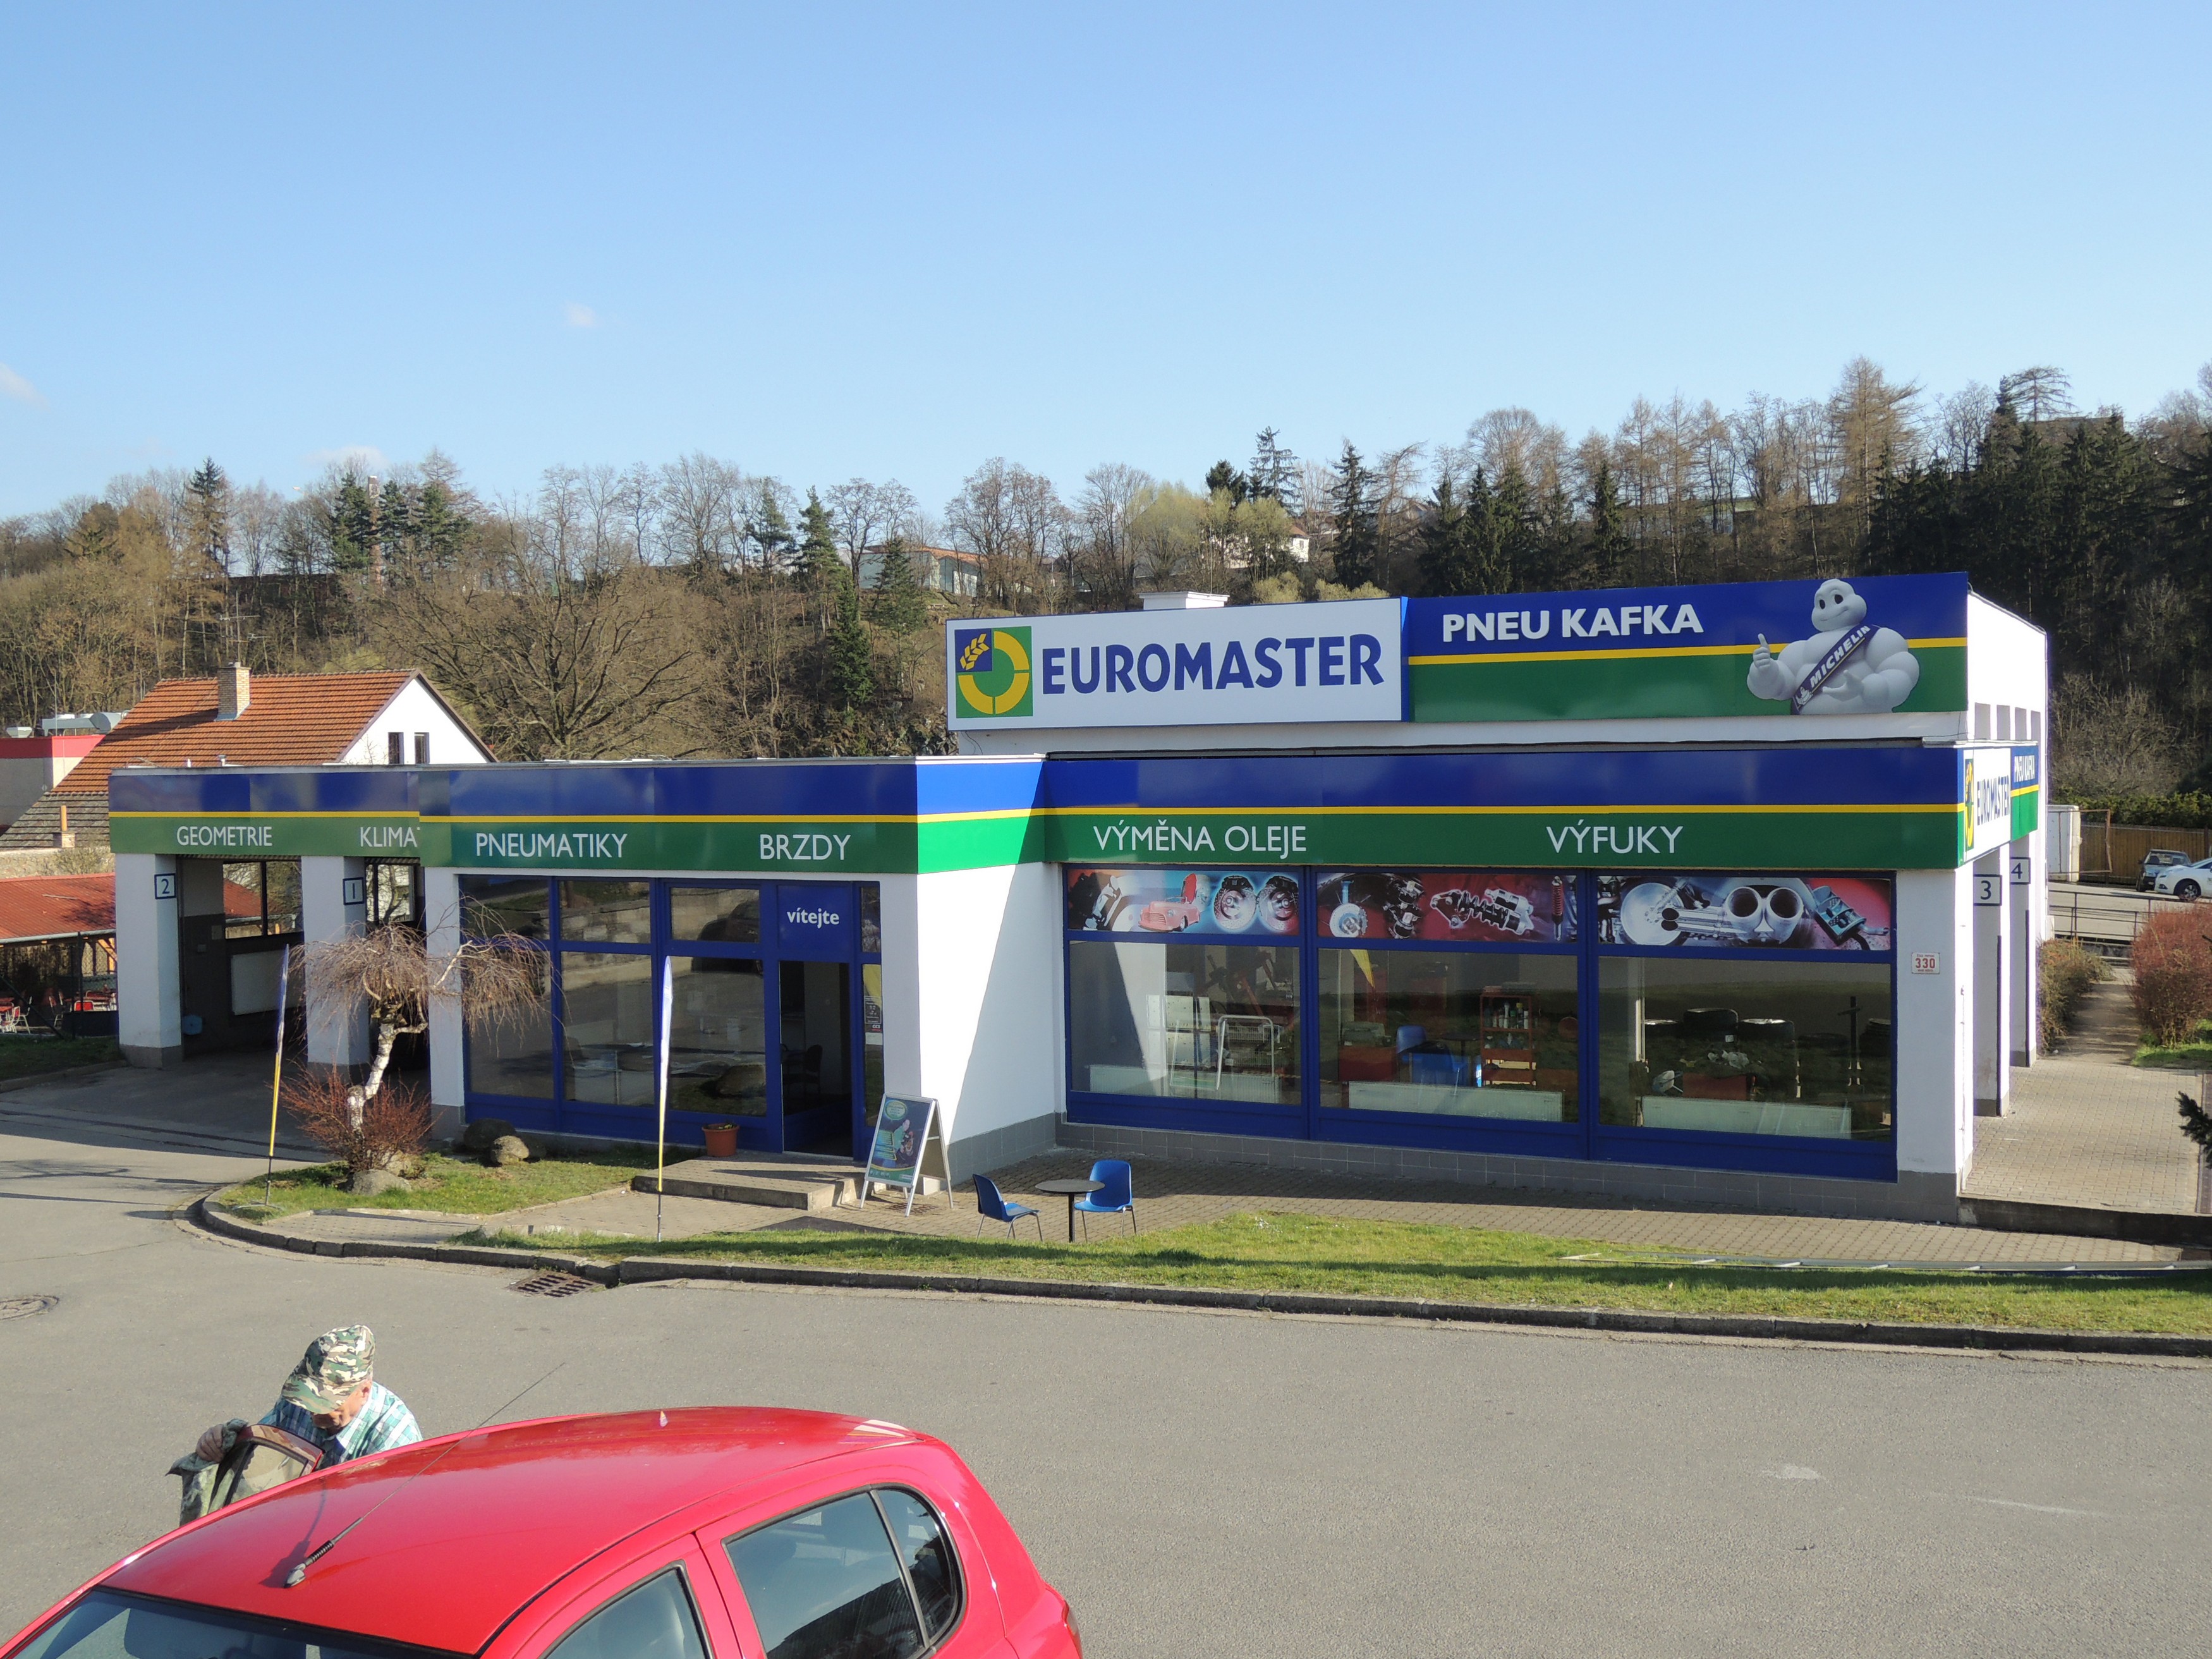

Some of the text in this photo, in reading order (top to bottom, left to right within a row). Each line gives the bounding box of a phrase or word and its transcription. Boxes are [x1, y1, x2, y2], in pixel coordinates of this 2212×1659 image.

[1443, 604, 1704, 643] PNEU KAFKA
[1043, 633, 1385, 695] EUROMASTER
[1809, 625, 1871, 688] MICHELIN
[1977, 775, 2010, 826] EUROMASTER
[176, 825, 272, 847] GEOMETRIE
[360, 826, 420, 848] KLIMA
[476, 832, 628, 858] PNEUMATIKY
[760, 834, 851, 861] BRZDY
[1093, 818, 1307, 860] VÝMĚNA OLEJE
[1546, 819, 1684, 854] VÝFUKY
[2011, 863, 2022, 879] 4
[161, 878, 169, 894] 2
[1980, 880, 1991, 900] 3
[786, 907, 839, 929] vítejte
[1915, 957, 1936, 969] 330
